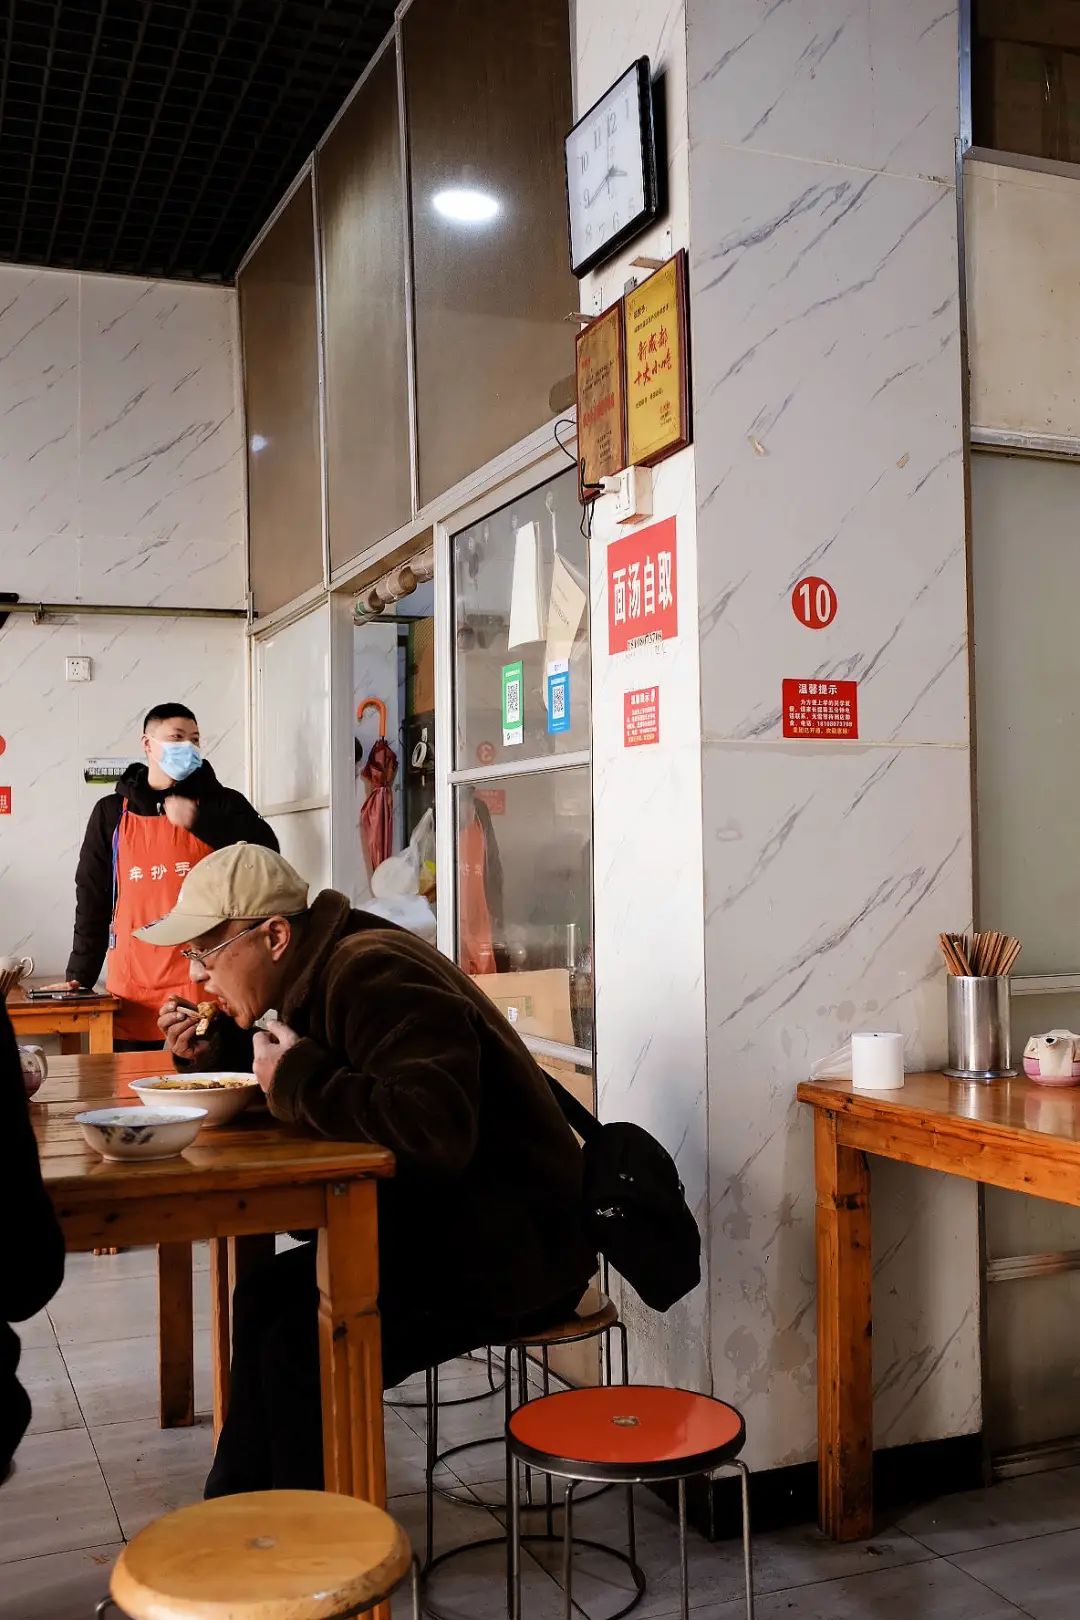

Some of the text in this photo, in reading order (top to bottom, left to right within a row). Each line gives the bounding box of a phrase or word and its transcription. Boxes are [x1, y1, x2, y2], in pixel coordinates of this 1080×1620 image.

[606, 114, 617, 137] 12
[593, 128, 602, 151] 11
[578, 151, 589, 175] 10
[612, 550, 673, 626] 面汤自取
[799, 583, 831, 623] 10
[799, 683, 838, 695] 温馨提示
